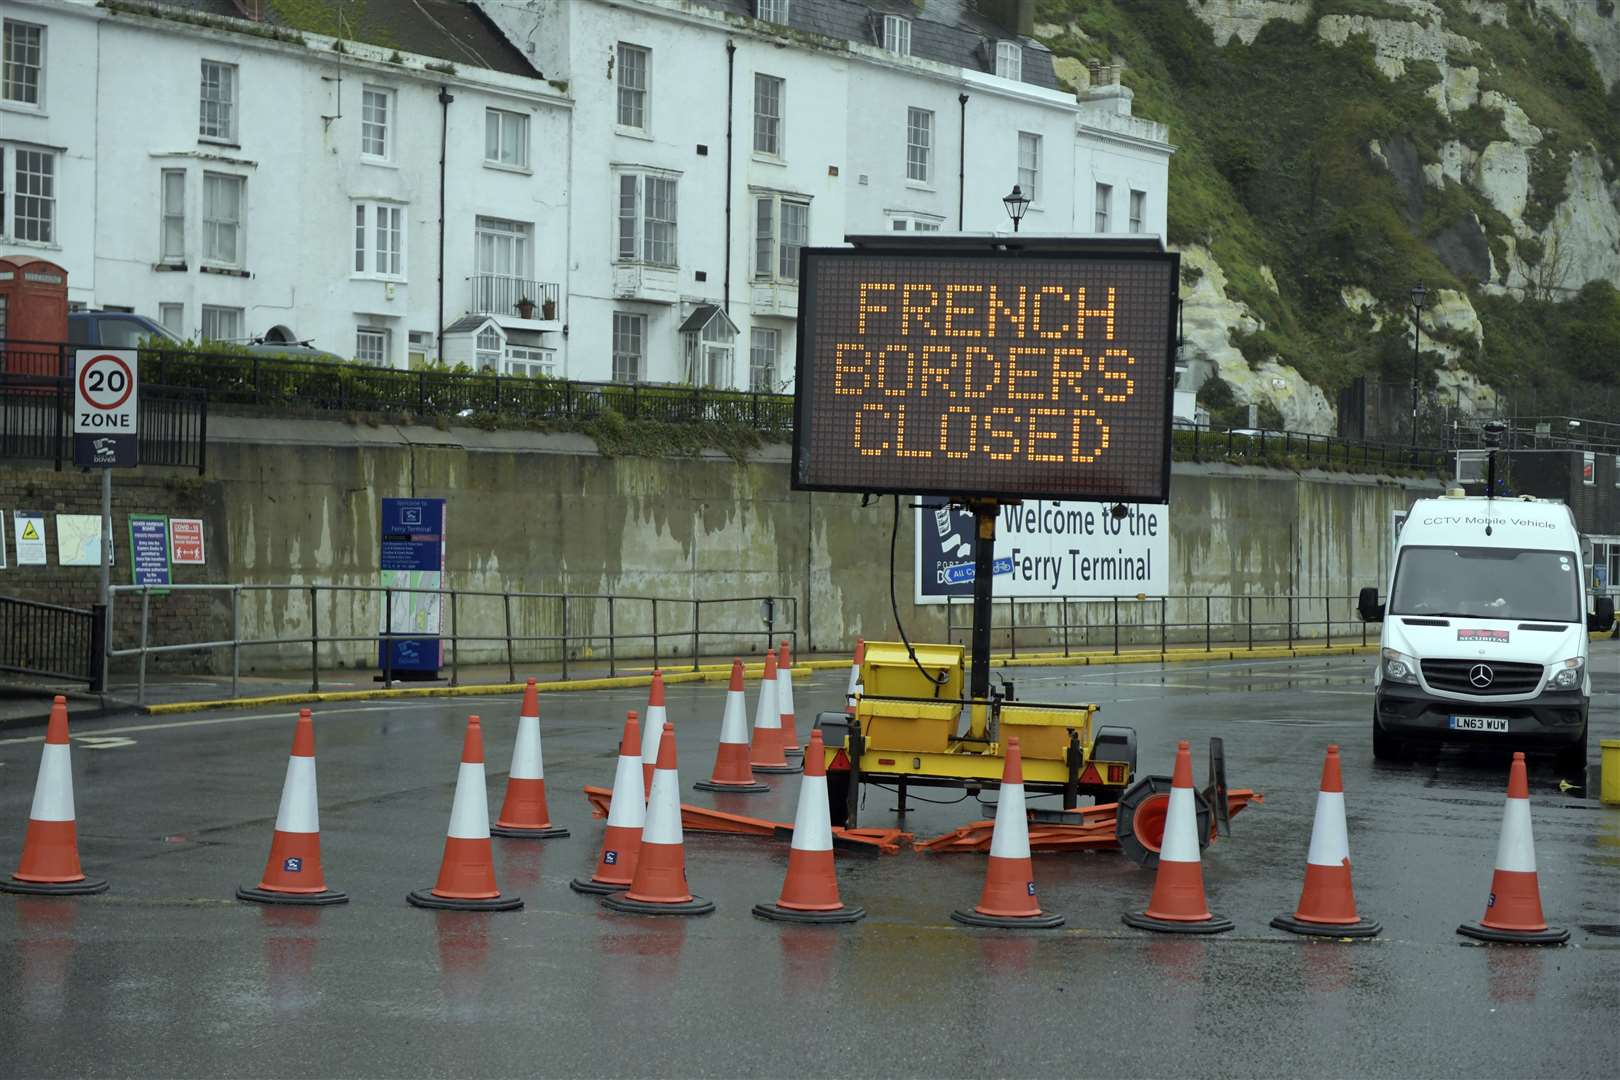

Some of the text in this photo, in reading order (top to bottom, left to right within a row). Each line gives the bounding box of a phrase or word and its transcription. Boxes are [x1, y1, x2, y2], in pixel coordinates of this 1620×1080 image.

[858, 282, 1116, 340] FRENCH
[88, 370, 125, 392] 20
[834, 342, 1135, 403] BORDERS
[80, 413, 130, 427] ZONE
[854, 403, 1111, 464] CLOSED
[1003, 499, 1158, 536] Welcome to the
[1423, 516, 1556, 529] CCTV Mobile Vehicle
[1012, 548, 1151, 590] Ferry Terminal
[1456, 718, 1484, 729] LN63
